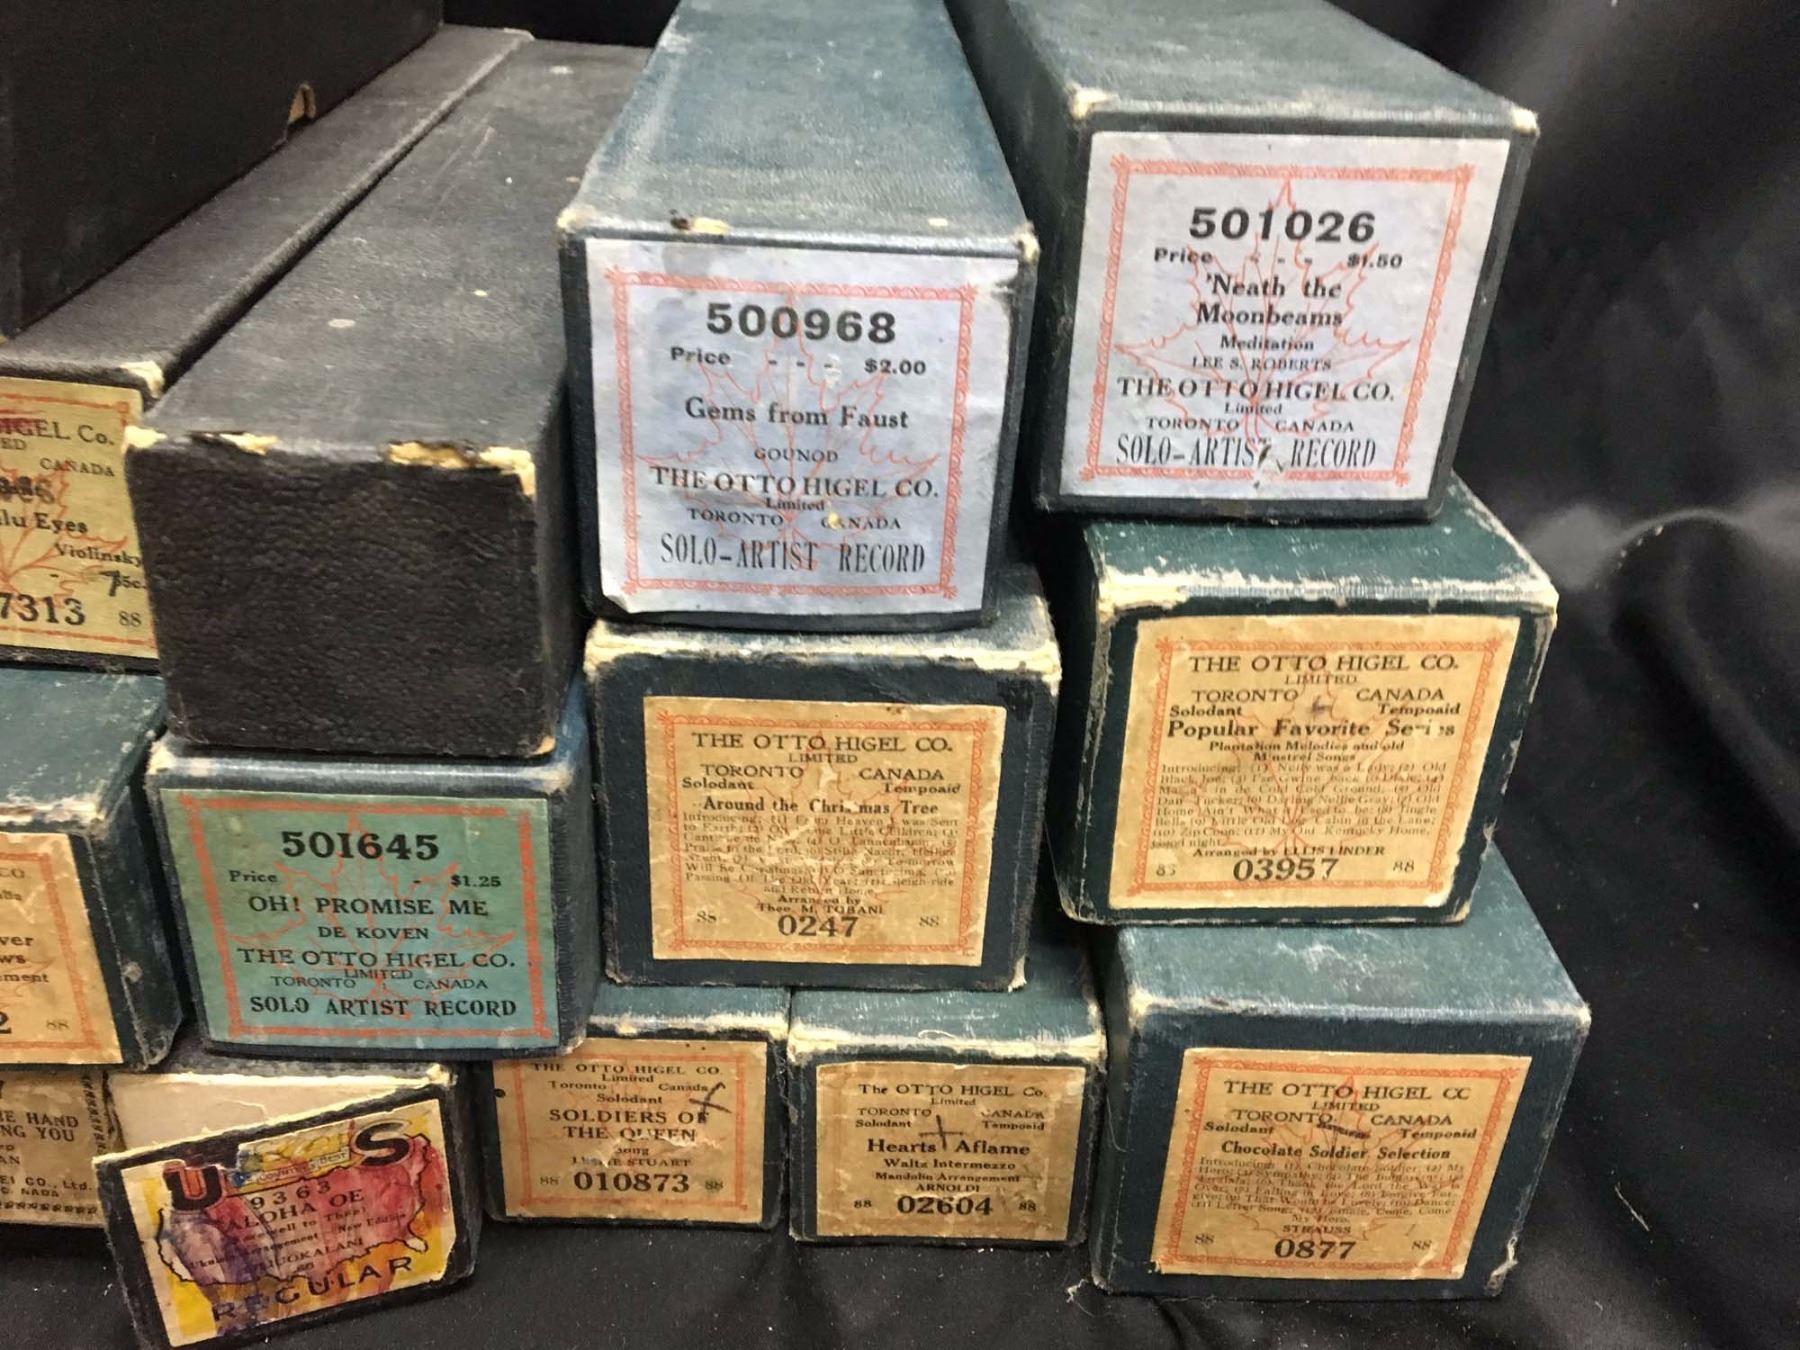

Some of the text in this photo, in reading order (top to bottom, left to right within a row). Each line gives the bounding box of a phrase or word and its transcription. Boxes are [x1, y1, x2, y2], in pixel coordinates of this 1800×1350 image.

[1189, 207, 1376, 242] 501026
[1154, 248, 1402, 269] Price $1.50
[1206, 274, 1341, 299] 'Neath the
[1197, 303, 1343, 327] Moonbeams
[707, 303, 896, 344] 500968
[1220, 336, 1314, 351] Meditation
[671, 347, 926, 375] Price $2.00
[1192, 357, 1223, 369] LEE
[1251, 358, 1332, 372] ROBERTS
[1117, 377, 1395, 401] THE OTTO HIGEL CO.
[686, 397, 909, 428] Gems from Faust
[1224, 402, 1283, 415] Limited
[1146, 417, 1353, 432] TORONTO CANADA
[78, 425, 114, 445] Co.
[754, 448, 838, 462] GOUNOD
[1291, 438, 1376, 467] RECORD
[40, 459, 115, 477] CANADA
[650, 467, 938, 498] THE OTTO HIGEL CO.
[766, 497, 825, 512] Limited
[34, 512, 87, 534] Eyes
[687, 508, 783, 527] TORONTO
[661, 534, 924, 573] SOLO-ARTIST RECORD
[119, 611, 142, 627] 88
[1189, 654, 1460, 673] THE OTTO HIGEL CO.
[1285, 674, 1358, 685] LIMITED
[1191, 688, 1444, 702] TORONTO CANADA
[1170, 704, 1460, 718] Solodant Tempoaid
[1167, 720, 1258, 739] Popular
[1274, 720, 1370, 737] Favorite
[692, 733, 953, 752] THE OTTO HIGEL CO.
[1209, 742, 1281, 752] Plantation
[789, 754, 858, 763] LIMITED
[701, 764, 944, 781] TORONTO CANADA
[682, 778, 754, 790] Solodant
[703, 798, 764, 813] Around
[773, 800, 799, 813] the
[901, 801, 939, 815] Tree
[282, 831, 439, 860] 501645
[1232, 858, 1339, 882] 03957
[1392, 861, 1415, 874] 88
[229, 870, 501, 888] Price $1.25
[248, 896, 489, 916] OH! PROMISE ME
[318, 926, 428, 940] DE KOVEN
[778, 915, 858, 937] 0247
[237, 947, 515, 967] THE OTTO HIGEL CO.
[344, 969, 413, 980] LIMITED
[270, 976, 488, 990] TORONTO CANADA
[251, 997, 516, 1017] SOLO ARTIST RECORD
[531, 1063, 686, 1075] THE OTTO HIGEL
[548, 1080, 708, 1092] Toronto Canada
[602, 1074, 654, 1083] Limited
[858, 1083, 887, 1095] The
[896, 1084, 952, 1096] OTTO
[960, 1085, 1014, 1097] HIGEL
[1224, 1081, 1273, 1095] THE
[1282, 1084, 1354, 1099] OTTO
[1363, 1085, 1432, 1100] HIGEL
[596, 1093, 662, 1105] Solodant
[931, 1097, 976, 1106] Limited
[1312, 1101, 1380, 1111] LIMITED
[26, 1112, 78, 1127] HAND
[550, 1109, 667, 1123] SOLDIERS
[857, 1107, 1045, 1119] TORONTO CANADA
[1232, 1109, 1452, 1126] TORONTO CANADA
[856, 1118, 912, 1129] Solodant
[1204, 1122, 1275, 1134] Solodant
[36, 1127, 74, 1141] YOU
[563, 1126, 608, 1139] THE
[355, 1122, 414, 1166] S
[868, 1138, 1031, 1155] Hearts Aflame
[1221, 1141, 1450, 1159] Chocolate Soldier Selection
[627, 1157, 692, 1167] STUART
[884, 1159, 1016, 1170] Waltz Intermezzo
[574, 1172, 689, 1193] 010873
[875, 1171, 1020, 1183] Mandolin Arrangement
[63, 1180, 92, 1190] Ltd.
[916, 1183, 980, 1193] ARNOLDI
[330, 1189, 365, 1207] OE
[854, 1199, 872, 1209] 88
[897, 1196, 993, 1216] 02604
[1018, 1202, 1036, 1212] 88
[1282, 1224, 1351, 1235] STRAUSS
[1275, 1239, 1356, 1260] 0877
